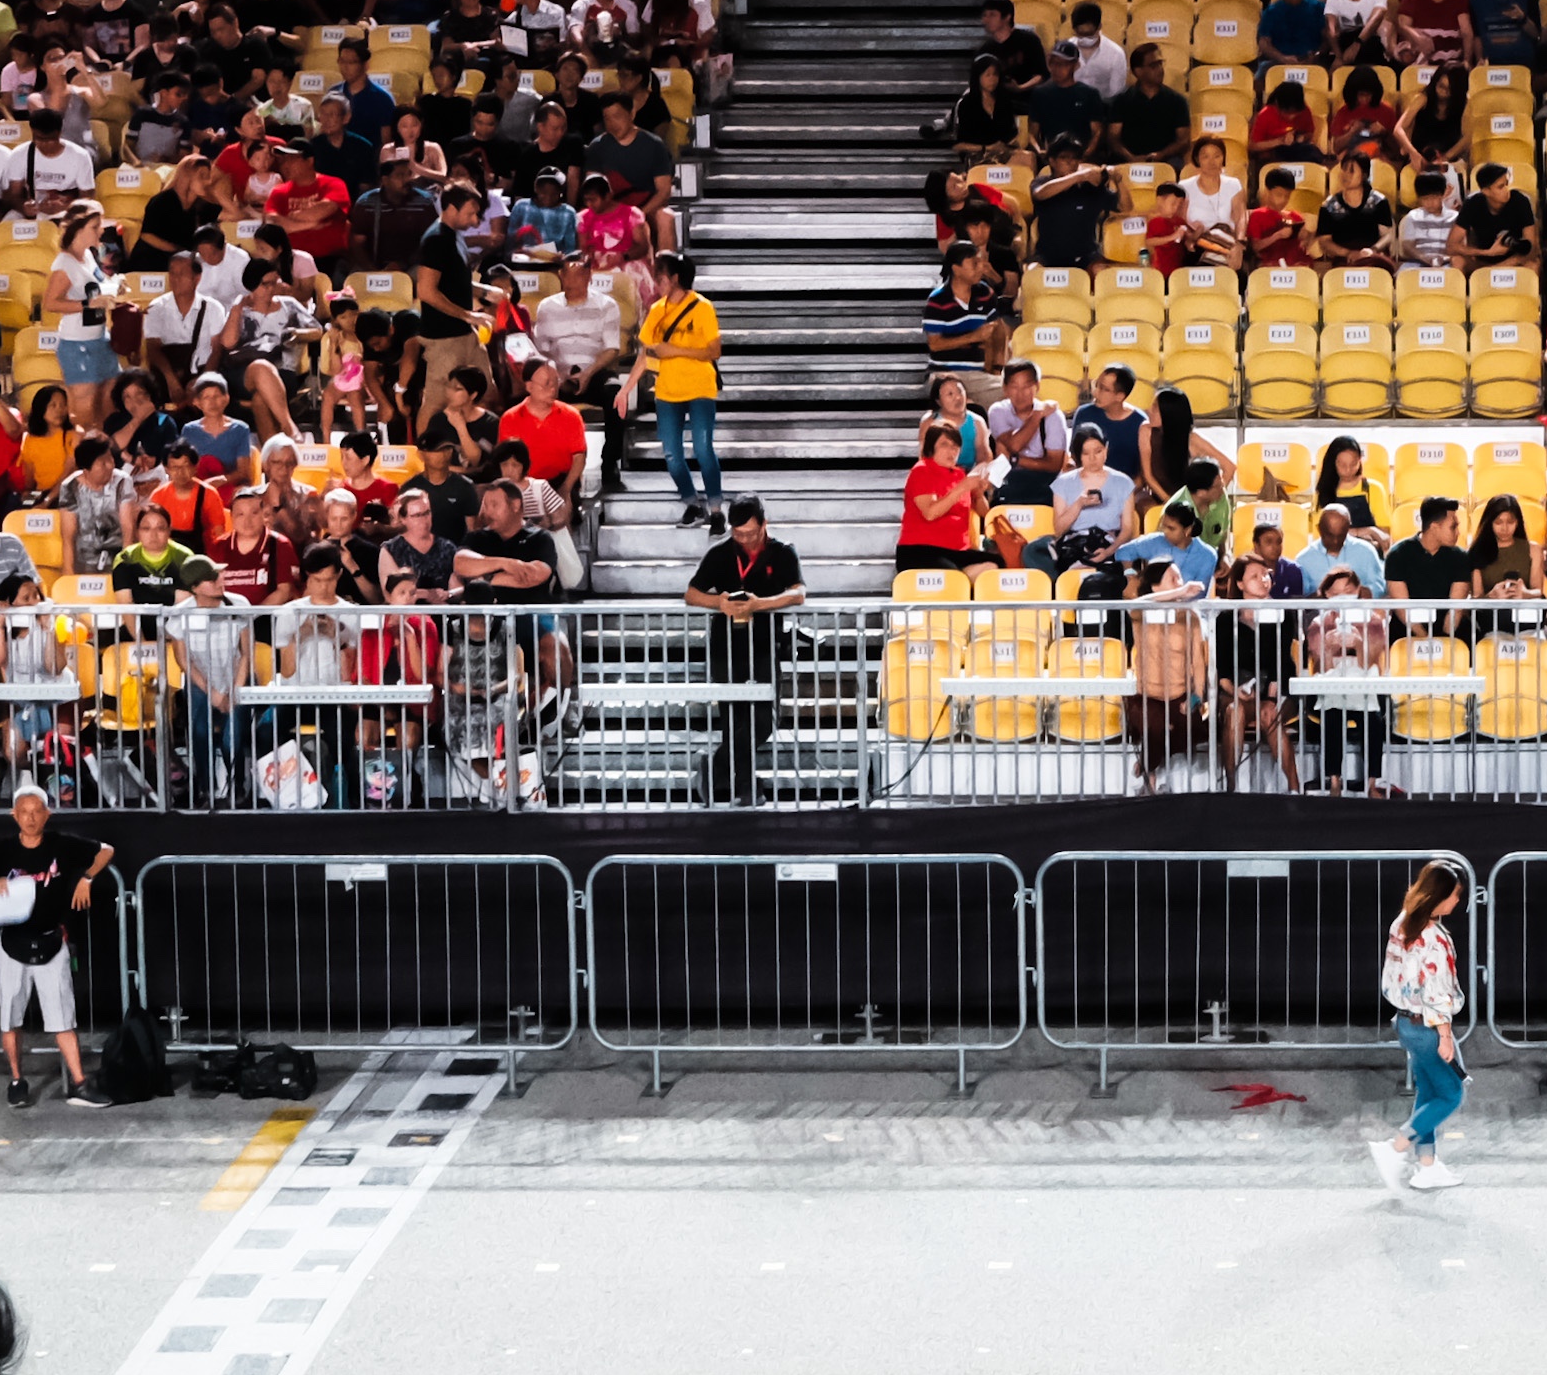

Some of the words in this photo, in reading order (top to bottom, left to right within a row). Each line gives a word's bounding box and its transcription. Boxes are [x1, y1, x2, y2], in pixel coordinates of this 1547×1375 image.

[1036, 332, 1059, 341] E315
[1113, 331, 1135, 339] E314
[1346, 330, 1367, 339] E311
[1008, 513, 1031, 524] C315
[918, 577, 943, 586] B316
[1001, 577, 1026, 587] B315
